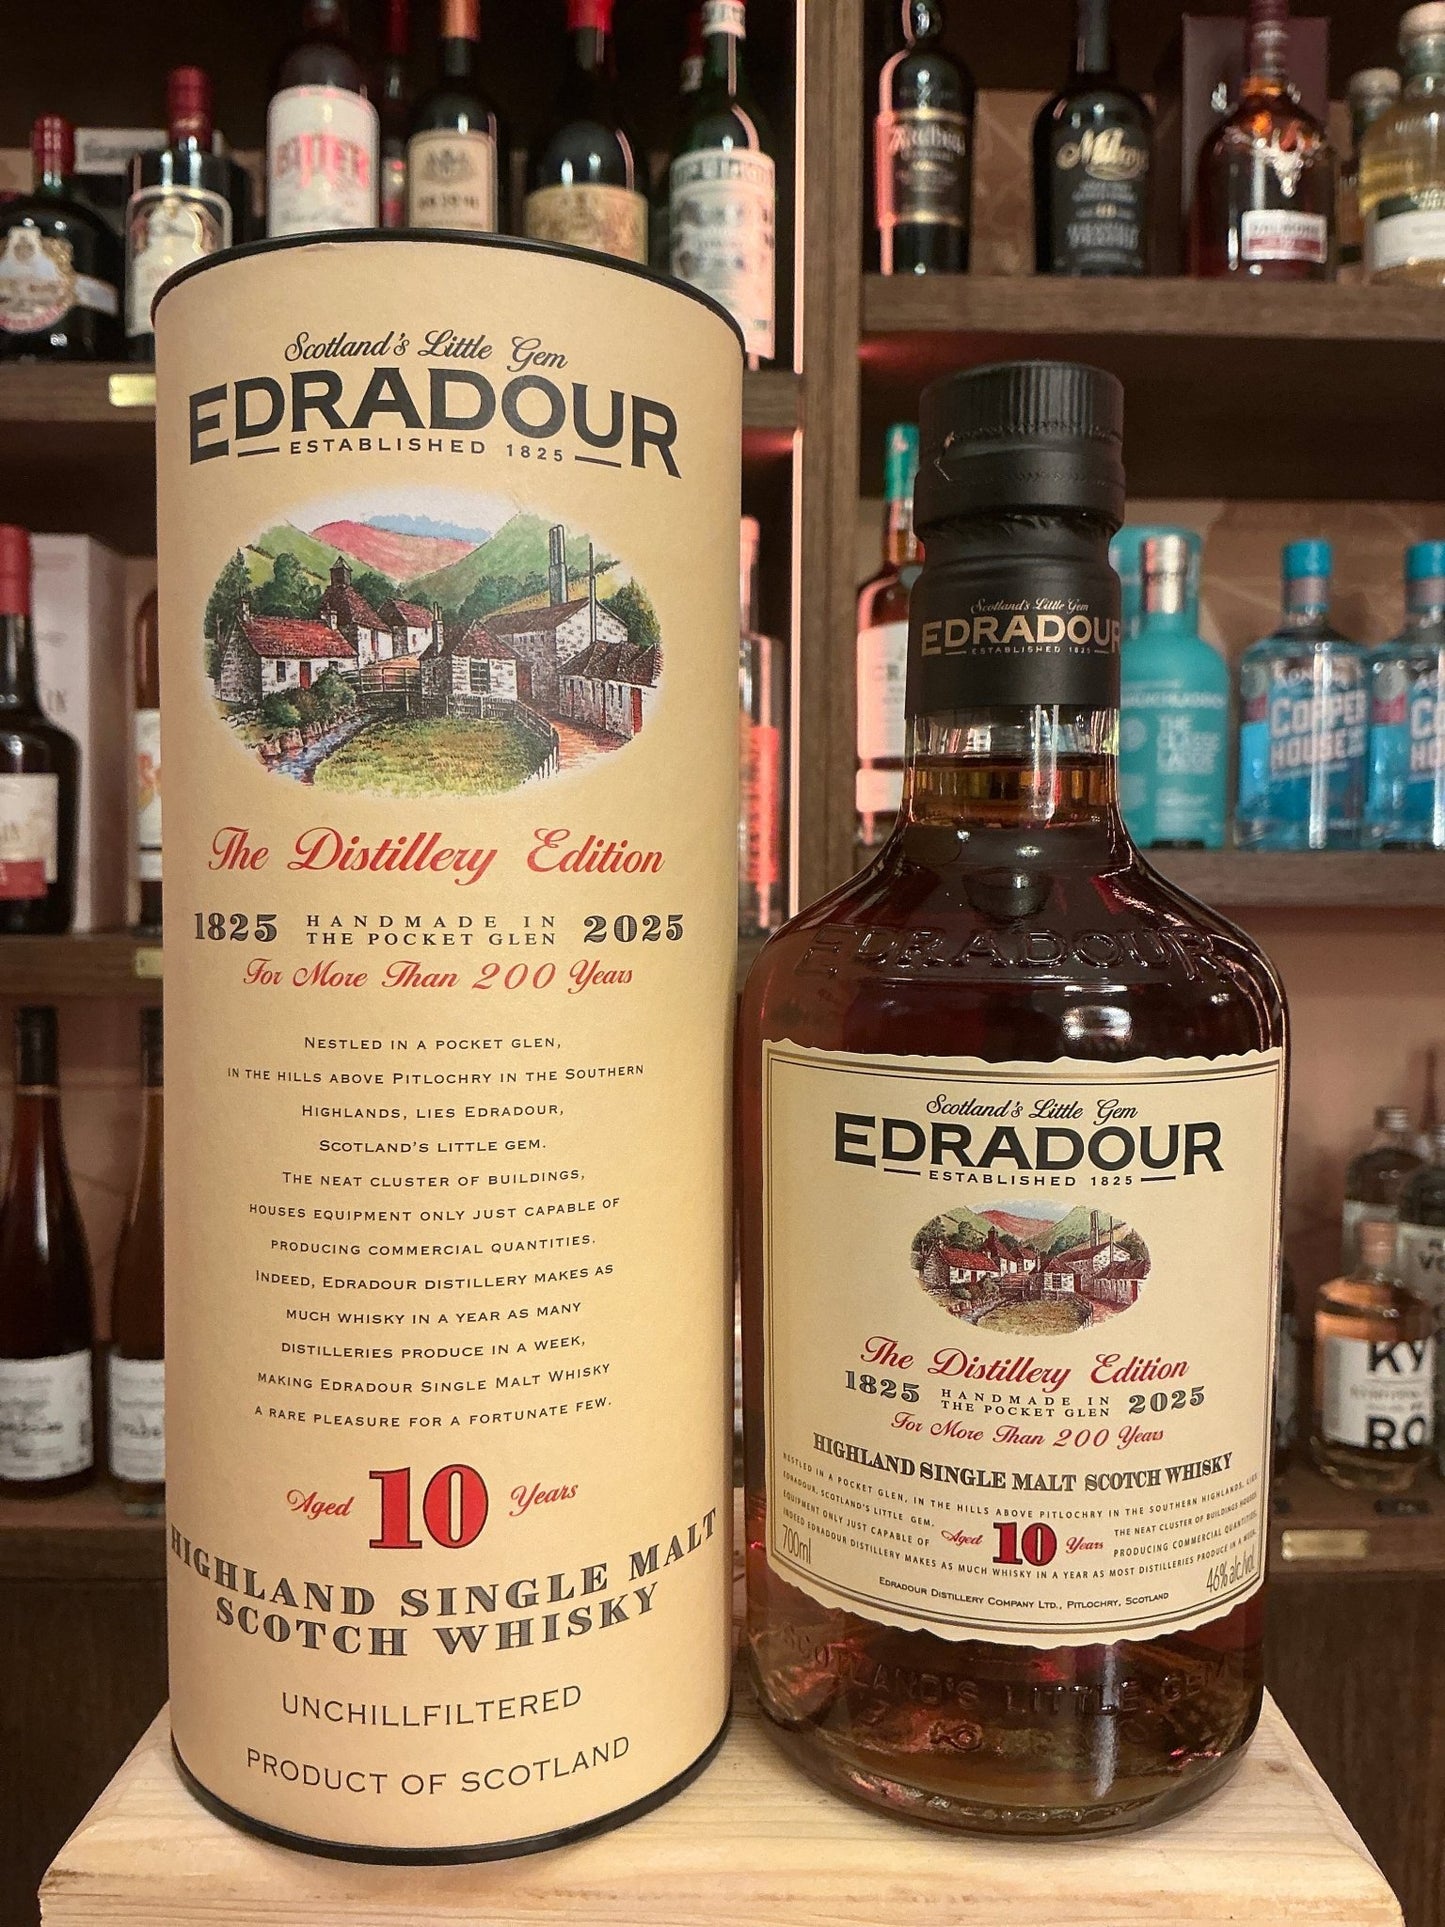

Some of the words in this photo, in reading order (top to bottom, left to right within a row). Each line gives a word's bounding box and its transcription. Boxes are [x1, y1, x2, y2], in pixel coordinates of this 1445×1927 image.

[285, 331, 409, 361] Scotland's
[417, 330, 492, 359] Little
[507, 336, 568, 372] Gem
[189, 367, 681, 479] EDRADOUR
[291, 438, 484, 454] ESTABLISHED
[507, 444, 562, 461] 1825
[971, 599, 1030, 614] Scotland's
[1033, 598, 1065, 612] Little
[1066, 599, 1089, 613] Gem
[921, 614, 1120, 656] EDRADOUR
[971, 646, 1061, 656] ESTABLISHED
[209, 827, 269, 870] The
[287, 827, 497, 886] Distillery
[527, 828, 665, 873] Edition
[195, 913, 277, 942] 1825
[307, 915, 496, 928] HANDMADE
[524, 916, 554, 927] IN
[584, 915, 683, 943] 2025
[307, 933, 361, 944] THE
[369, 933, 473, 945] POCKET
[489, 933, 554, 945] GLEN
[244, 958, 281, 984] For
[293, 961, 367, 987] More
[382, 961, 460, 987] Than
[472, 963, 556, 989] 200
[568, 960, 632, 994] Years
[392, 1041, 407, 1049] IN
[417, 1041, 426, 1049] A
[436, 1040, 502, 1049] POCKET
[512, 1038, 560, 1048] GLEN,
[228, 1068, 239, 1077] IN
[245, 1070, 270, 1080] THE
[278, 1072, 321, 1082] HILLS
[330, 1074, 383, 1084] ABOVE
[501, 1073, 516, 1082] IN
[526, 1071, 557, 1081] THE
[417, 1109, 455, 1118] LIES
[927, 1094, 1023, 1118] Scotland's
[1029, 1099, 1083, 1119] Little
[1093, 1099, 1138, 1125] Gem
[438, 1142, 497, 1152] LITTLE
[505, 1140, 545, 1150] GEM.
[835, 1112, 1224, 1175] EDRADOUR
[321, 1176, 362, 1186] NEAT
[371, 1177, 448, 1187] CLUSTER
[458, 1176, 479, 1186] OF
[489, 1170, 584, 1185] BUILDINGS,
[930, 1170, 1075, 1186] ESTABLISHED
[1091, 1176, 1132, 1186] 1825
[250, 1204, 305, 1218] HOUSES
[314, 1210, 411, 1221] EQUIPMENT
[420, 1211, 464, 1221] ONLY
[473, 1208, 516, 1219] JUST
[525, 1201, 595, 1216] CAPABLE
[603, 1198, 619, 1208] OF
[272, 1240, 360, 1255] PRODUCING
[369, 1245, 482, 1255] COMMERCIAL
[492, 1235, 595, 1253] QUANTITIES.
[425, 1275, 527, 1289] DISTILLERY
[535, 1268, 588, 1283] MAKES
[595, 1265, 613, 1275] AS
[287, 1310, 329, 1321] MUCH
[413, 1315, 429, 1324] IN
[438, 1314, 448, 1323] A
[456, 1312, 500, 1322] YEAR
[507, 1309, 528, 1319] AS
[537, 1303, 580, 1316] MANY
[282, 1343, 392, 1358] DISTILLERIES
[402, 1347, 483, 1358] PRODUCE
[493, 1345, 508, 1354] IN
[517, 1343, 526, 1352] A
[534, 1336, 584, 1350] WEEK,
[861, 1336, 913, 1369] The
[928, 1348, 1071, 1393] Distillery
[1091, 1354, 1187, 1383] Edition
[258, 1373, 312, 1388] MAKING
[846, 1371, 919, 1402] 1825
[941, 1389, 1070, 1406] HANDMADE
[1088, 1397, 1108, 1405] IN
[1129, 1386, 1204, 1414] 2025
[255, 1406, 262, 1415] A
[270, 1408, 305, 1422] RARE
[314, 1414, 399, 1427] PLEASURE
[410, 1417, 441, 1427] FOR
[451, 1417, 460, 1425] A
[470, 1405, 567, 1424] FORTUNATE
[577, 1397, 611, 1411] FEW.
[941, 1400, 974, 1412] THE
[985, 1405, 1054, 1416] POCKET
[1065, 1408, 1108, 1417] GLEN
[891, 1412, 922, 1435] For
[931, 1420, 983, 1440] More
[993, 1425, 1045, 1445] Than
[1053, 1429, 1109, 1447] 200
[1117, 1425, 1163, 1450] Years
[814, 1432, 915, 1477] HIGHLAND
[920, 1462, 1006, 1488] SINGLE
[1012, 1473, 1076, 1491] MALT
[1085, 1469, 1161, 1491] SCOTCH
[1165, 1452, 1232, 1484] WHISKY
[287, 1489, 354, 1520] Aged
[369, 1464, 488, 1549] 10
[509, 1483, 578, 1516] Years
[782, 1522, 811, 1565] 700ml
[941, 1530, 983, 1546] Aged
[993, 1522, 1058, 1566] 10
[1066, 1537, 1103, 1553] Years
[1114, 1543, 1168, 1557] PRODUCING
[1173, 1528, 1221, 1549] COMMERCIAL
[172, 1525, 375, 1616] HIGHLAND
[401, 1563, 608, 1617] SINGLE
[629, 1508, 715, 1581] MALT
[217, 1596, 408, 1656] SCOTCH
[432, 1582, 657, 1654] WHISKY
[283, 1686, 580, 1726] UNCHILLFILTERED
[248, 1748, 387, 1794] PRODUCT
[402, 1774, 446, 1795] OF
[462, 1737, 629, 1792] SCOTLAND
